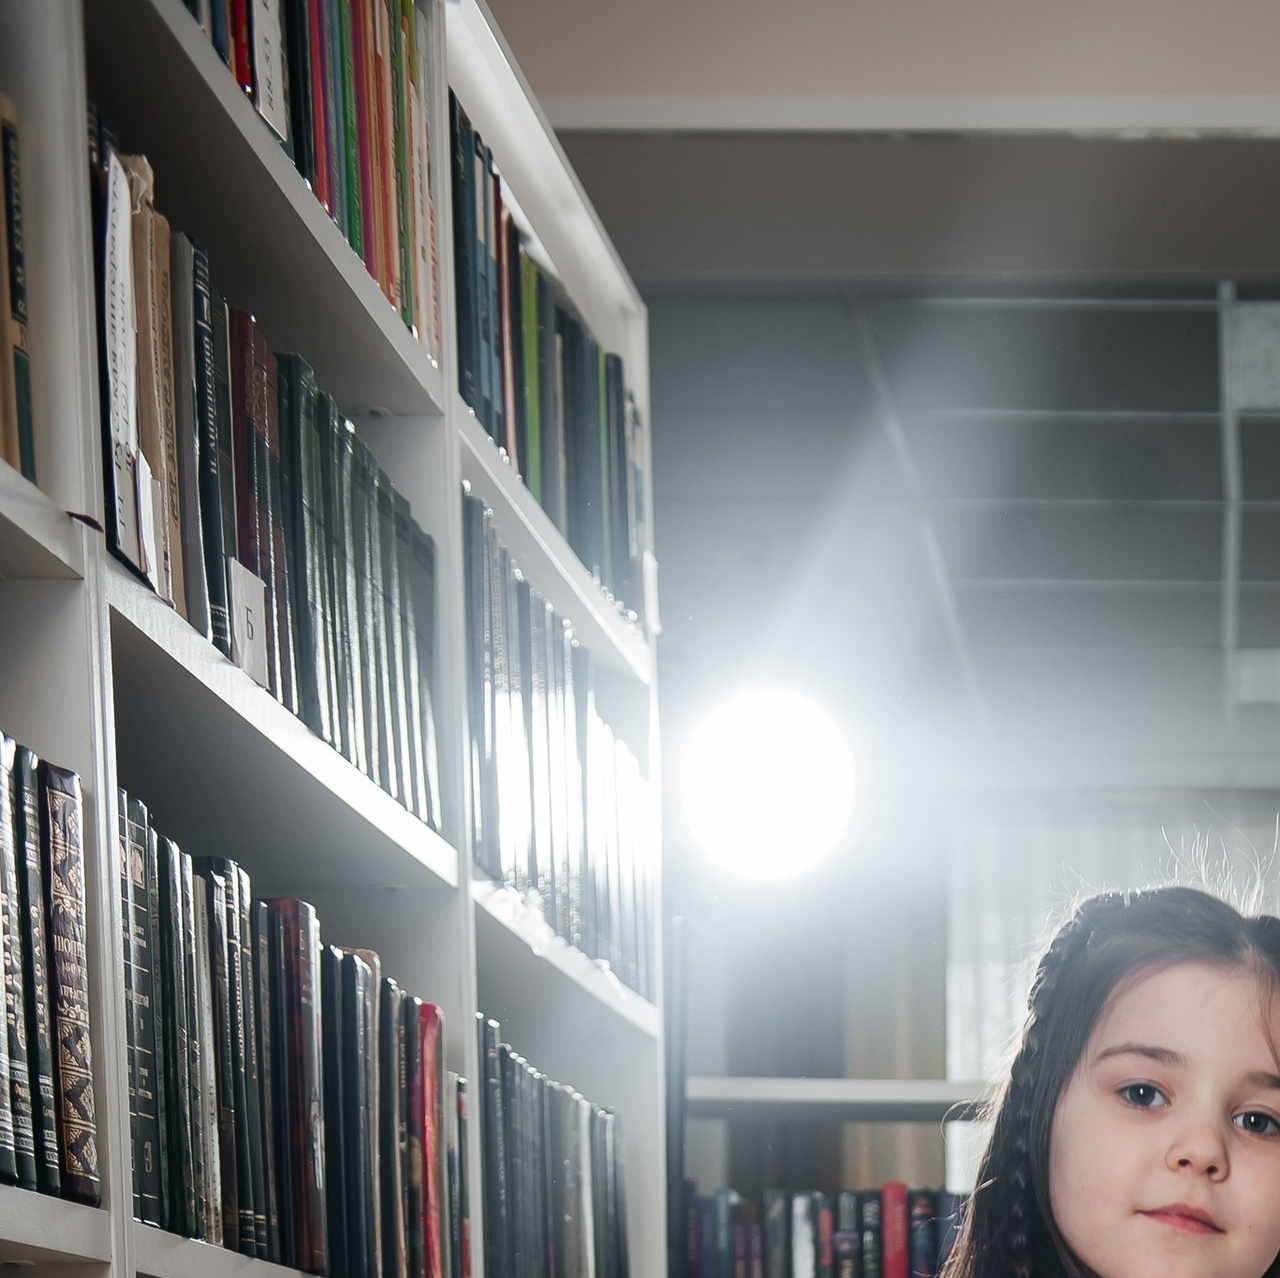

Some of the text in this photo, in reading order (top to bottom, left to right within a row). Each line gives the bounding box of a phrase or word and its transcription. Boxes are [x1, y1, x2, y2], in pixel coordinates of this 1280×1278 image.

[108, 164, 119, 343] литература
[110, 350, 123, 471] Русская
[124, 442, 133, 478] до
[243, 605, 253, 640] Б
[30, 904, 45, 1035] НИКОЛАЙ
